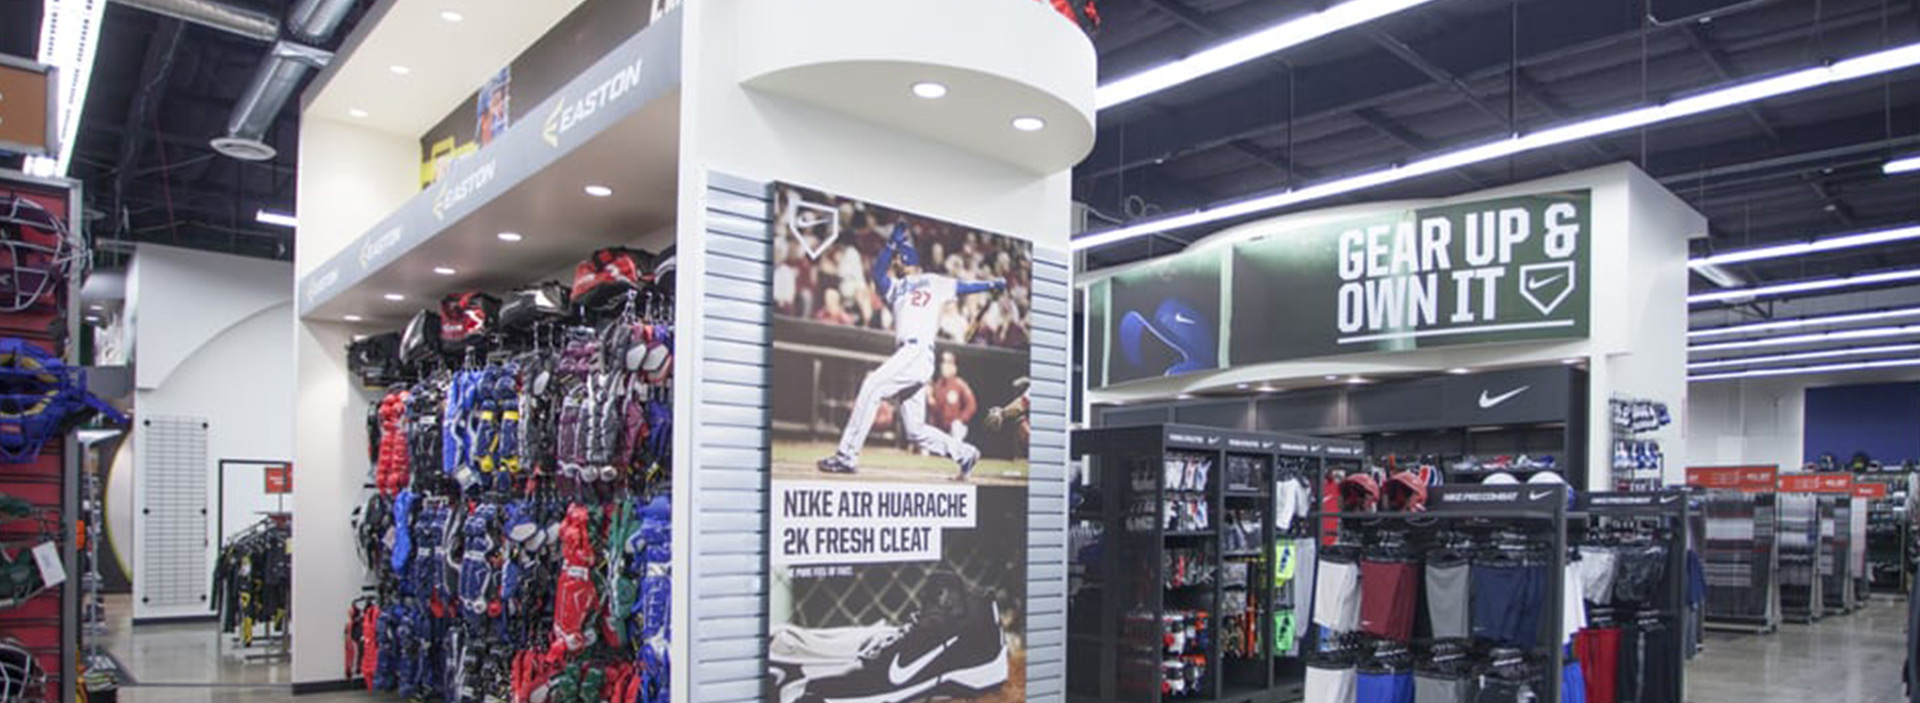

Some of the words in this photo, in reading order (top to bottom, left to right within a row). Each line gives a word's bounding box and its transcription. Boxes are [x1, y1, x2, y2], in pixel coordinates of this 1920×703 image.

[559, 60, 643, 133] EASTON
[443, 160, 496, 210] EASTON
[1338, 217, 1452, 281] GEAR
[1465, 207, 1530, 266] UP
[1543, 203, 1580, 258] &
[911, 290, 931, 307] 27
[1337, 272, 1438, 333] OWN
[1451, 266, 1505, 322] IT
[783, 490, 833, 518] NIKE
[838, 491, 873, 517] AIR
[878, 492, 967, 518] HUARACHE
[783, 528, 809, 555] 2K
[815, 527, 875, 553] FRESH
[880, 527, 931, 552] CLEAT
